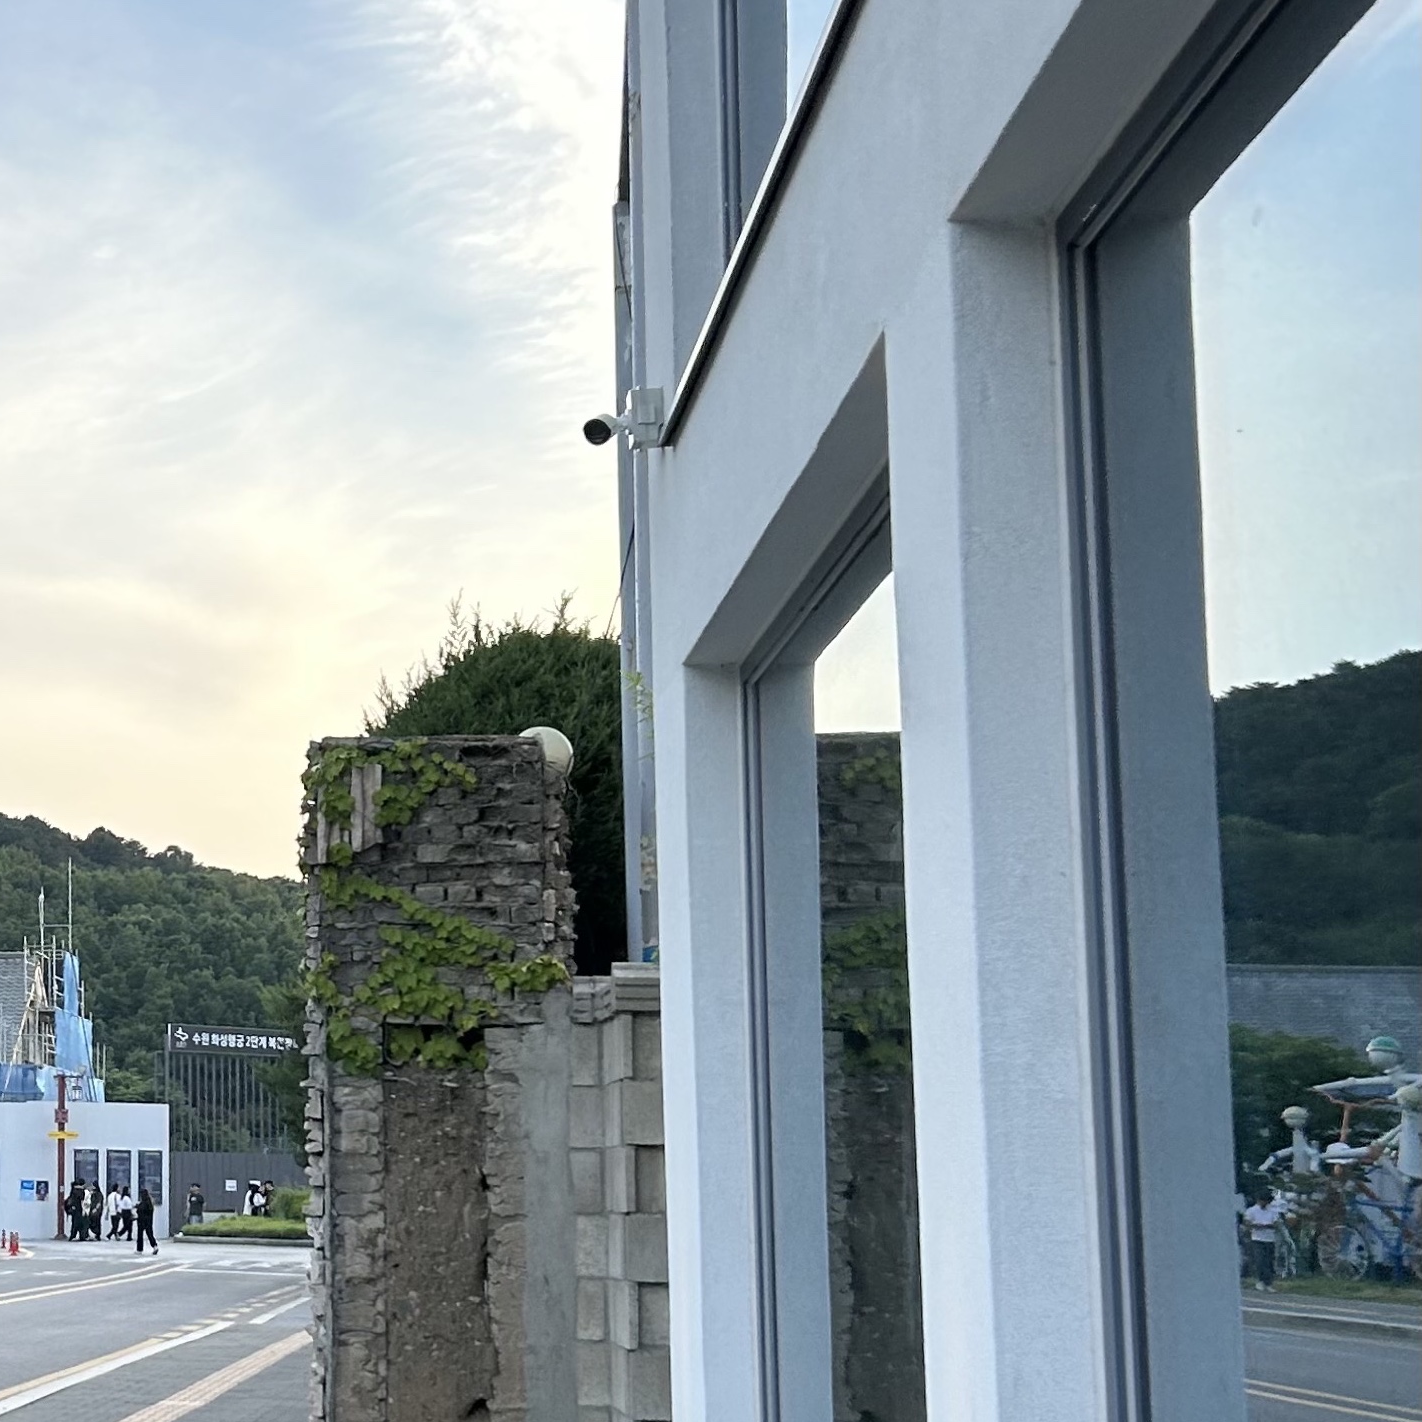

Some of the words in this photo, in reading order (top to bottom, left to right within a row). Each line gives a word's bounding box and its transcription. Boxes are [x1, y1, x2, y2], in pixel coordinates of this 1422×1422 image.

[192, 1032, 209, 1046] 수원
[211, 1033, 244, 1048] 화성행궁
[246, 1035, 267, 1049] 2단계
